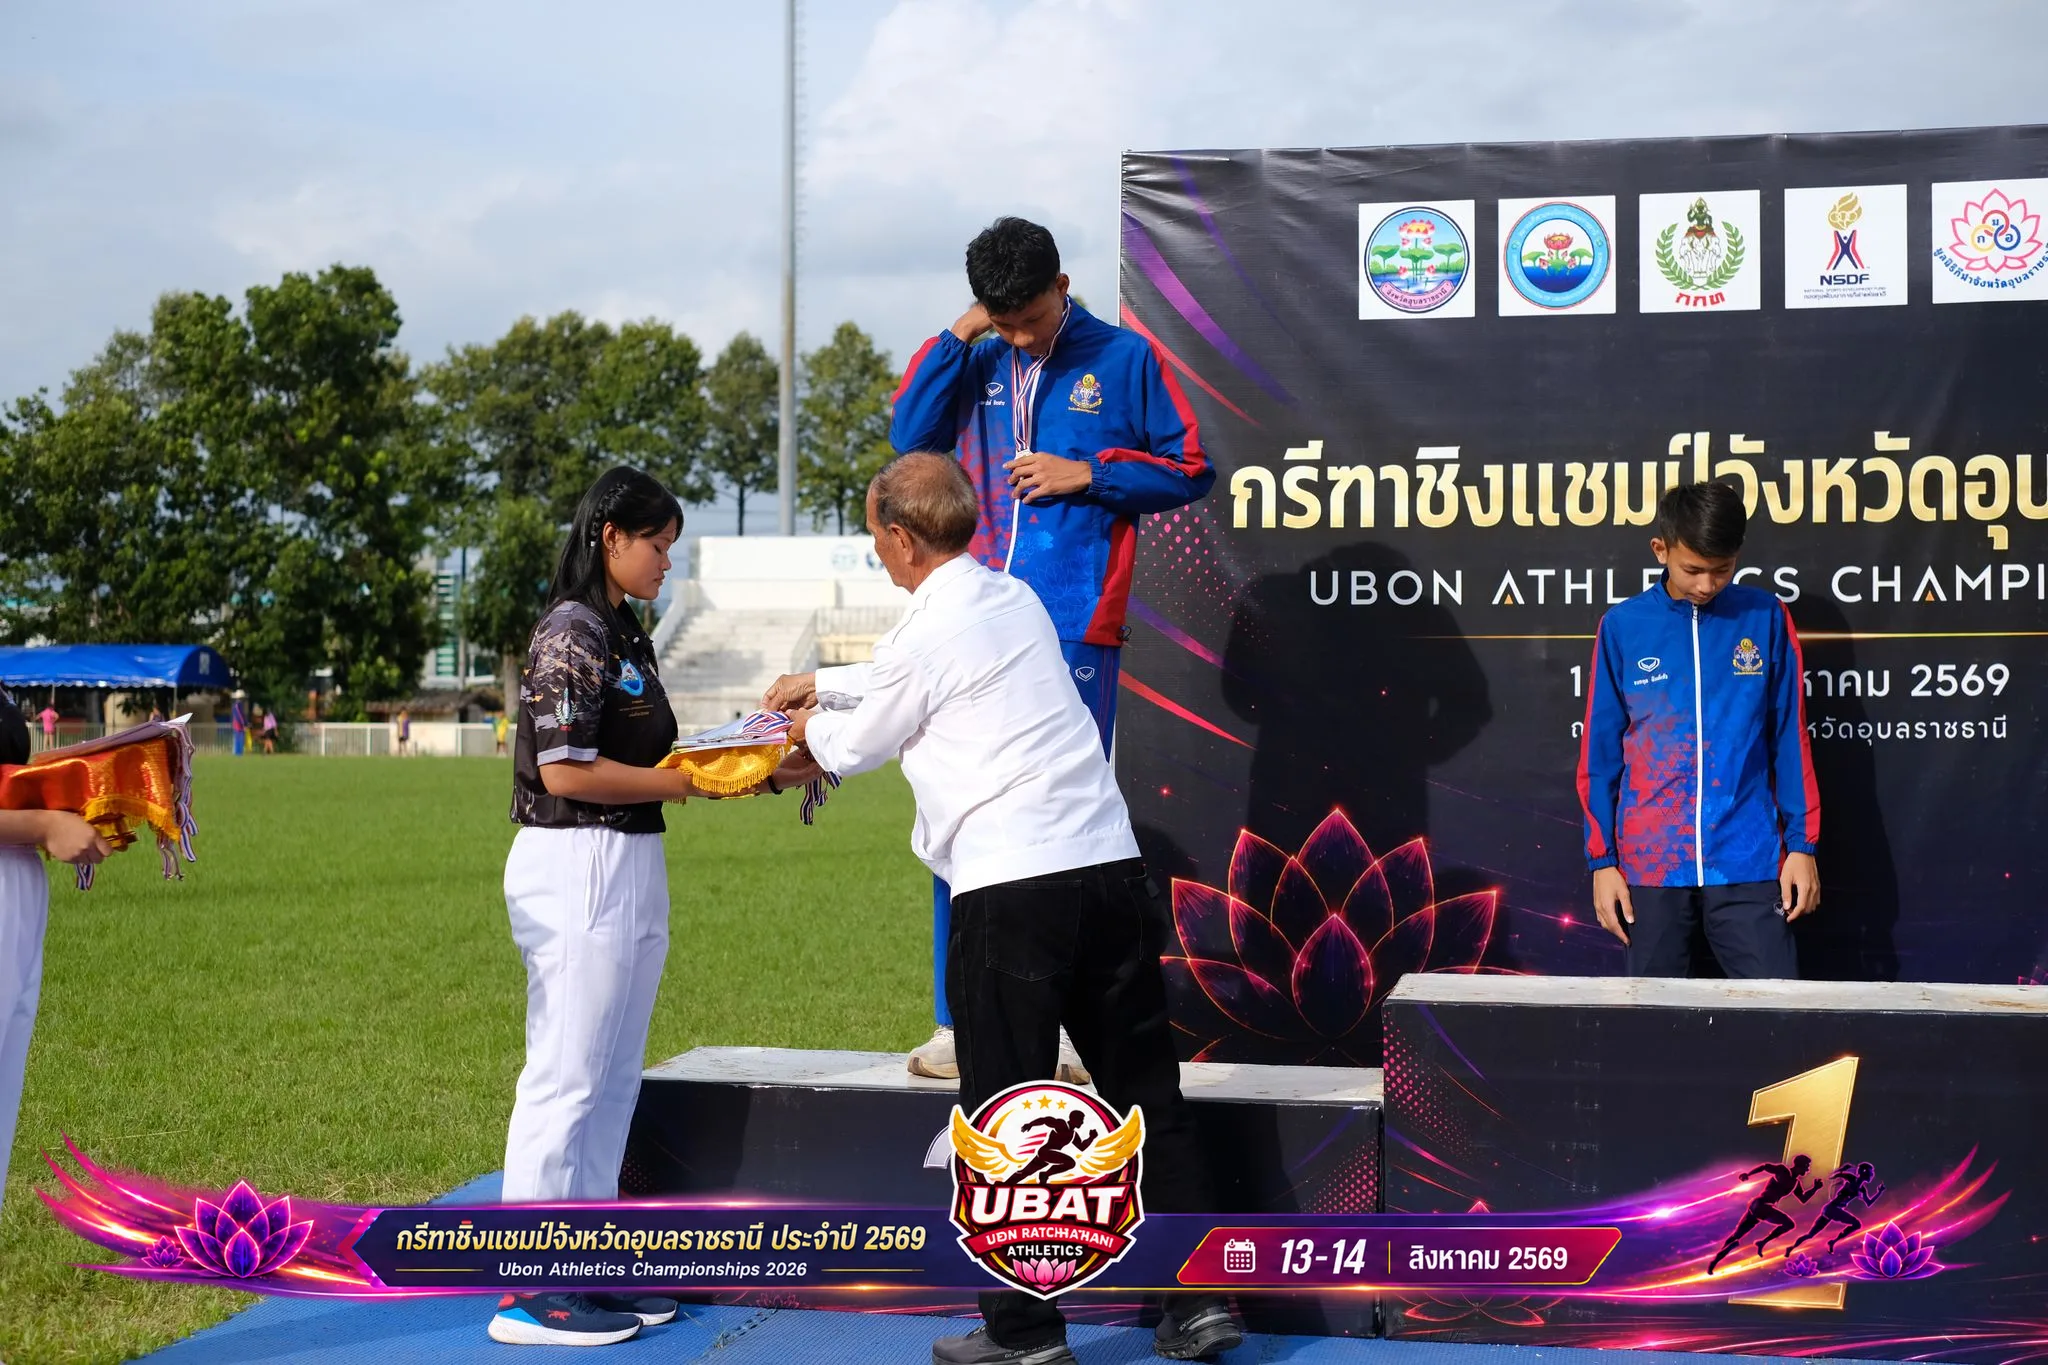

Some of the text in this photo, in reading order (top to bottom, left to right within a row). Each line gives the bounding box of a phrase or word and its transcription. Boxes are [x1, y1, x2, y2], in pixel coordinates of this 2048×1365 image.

[1820, 273, 1870, 286] NSDF
[1675, 291, 1726, 307] กกท
[1310, 569, 1463, 606] UBON
[1831, 563, 2045, 603] CHAMPI
[1910, 663, 2010, 697] 2569
